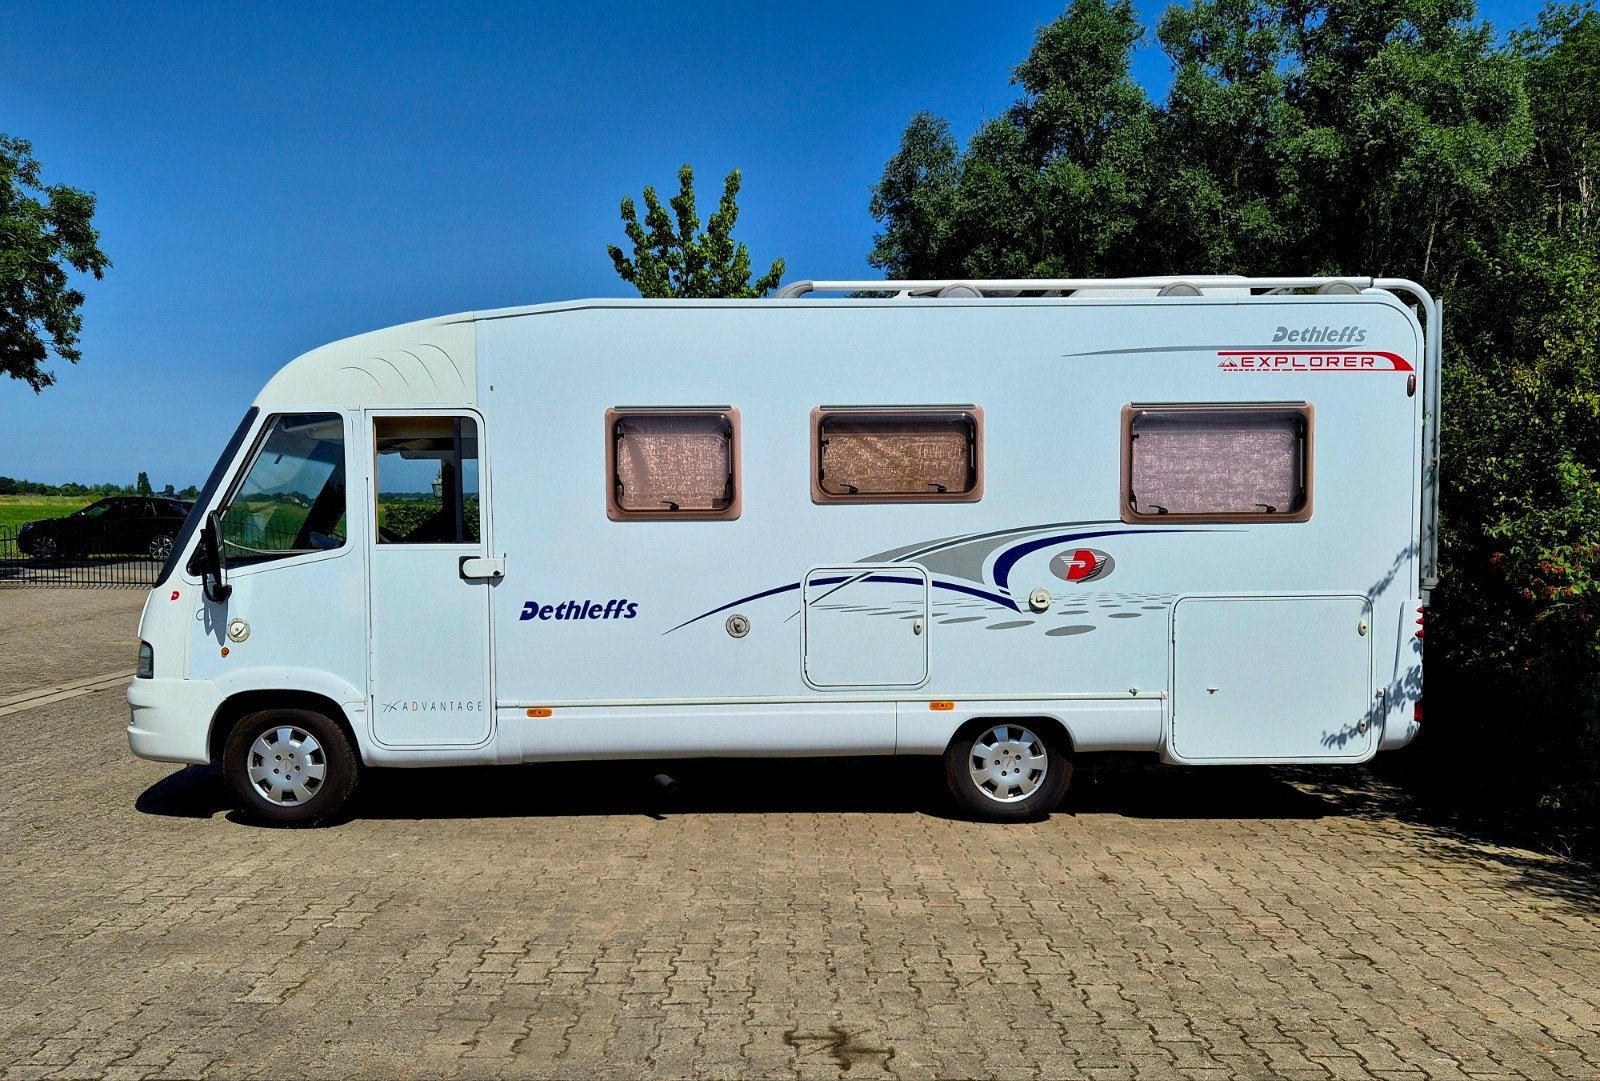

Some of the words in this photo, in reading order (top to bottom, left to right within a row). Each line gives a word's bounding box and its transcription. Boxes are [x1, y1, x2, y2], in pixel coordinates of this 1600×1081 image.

[1272, 325, 1367, 343] Dethleffs
[1241, 356, 1375, 368] EXPLORER
[519, 599, 639, 621] Dethleffs
[402, 701, 482, 712] ADVANTAGE
